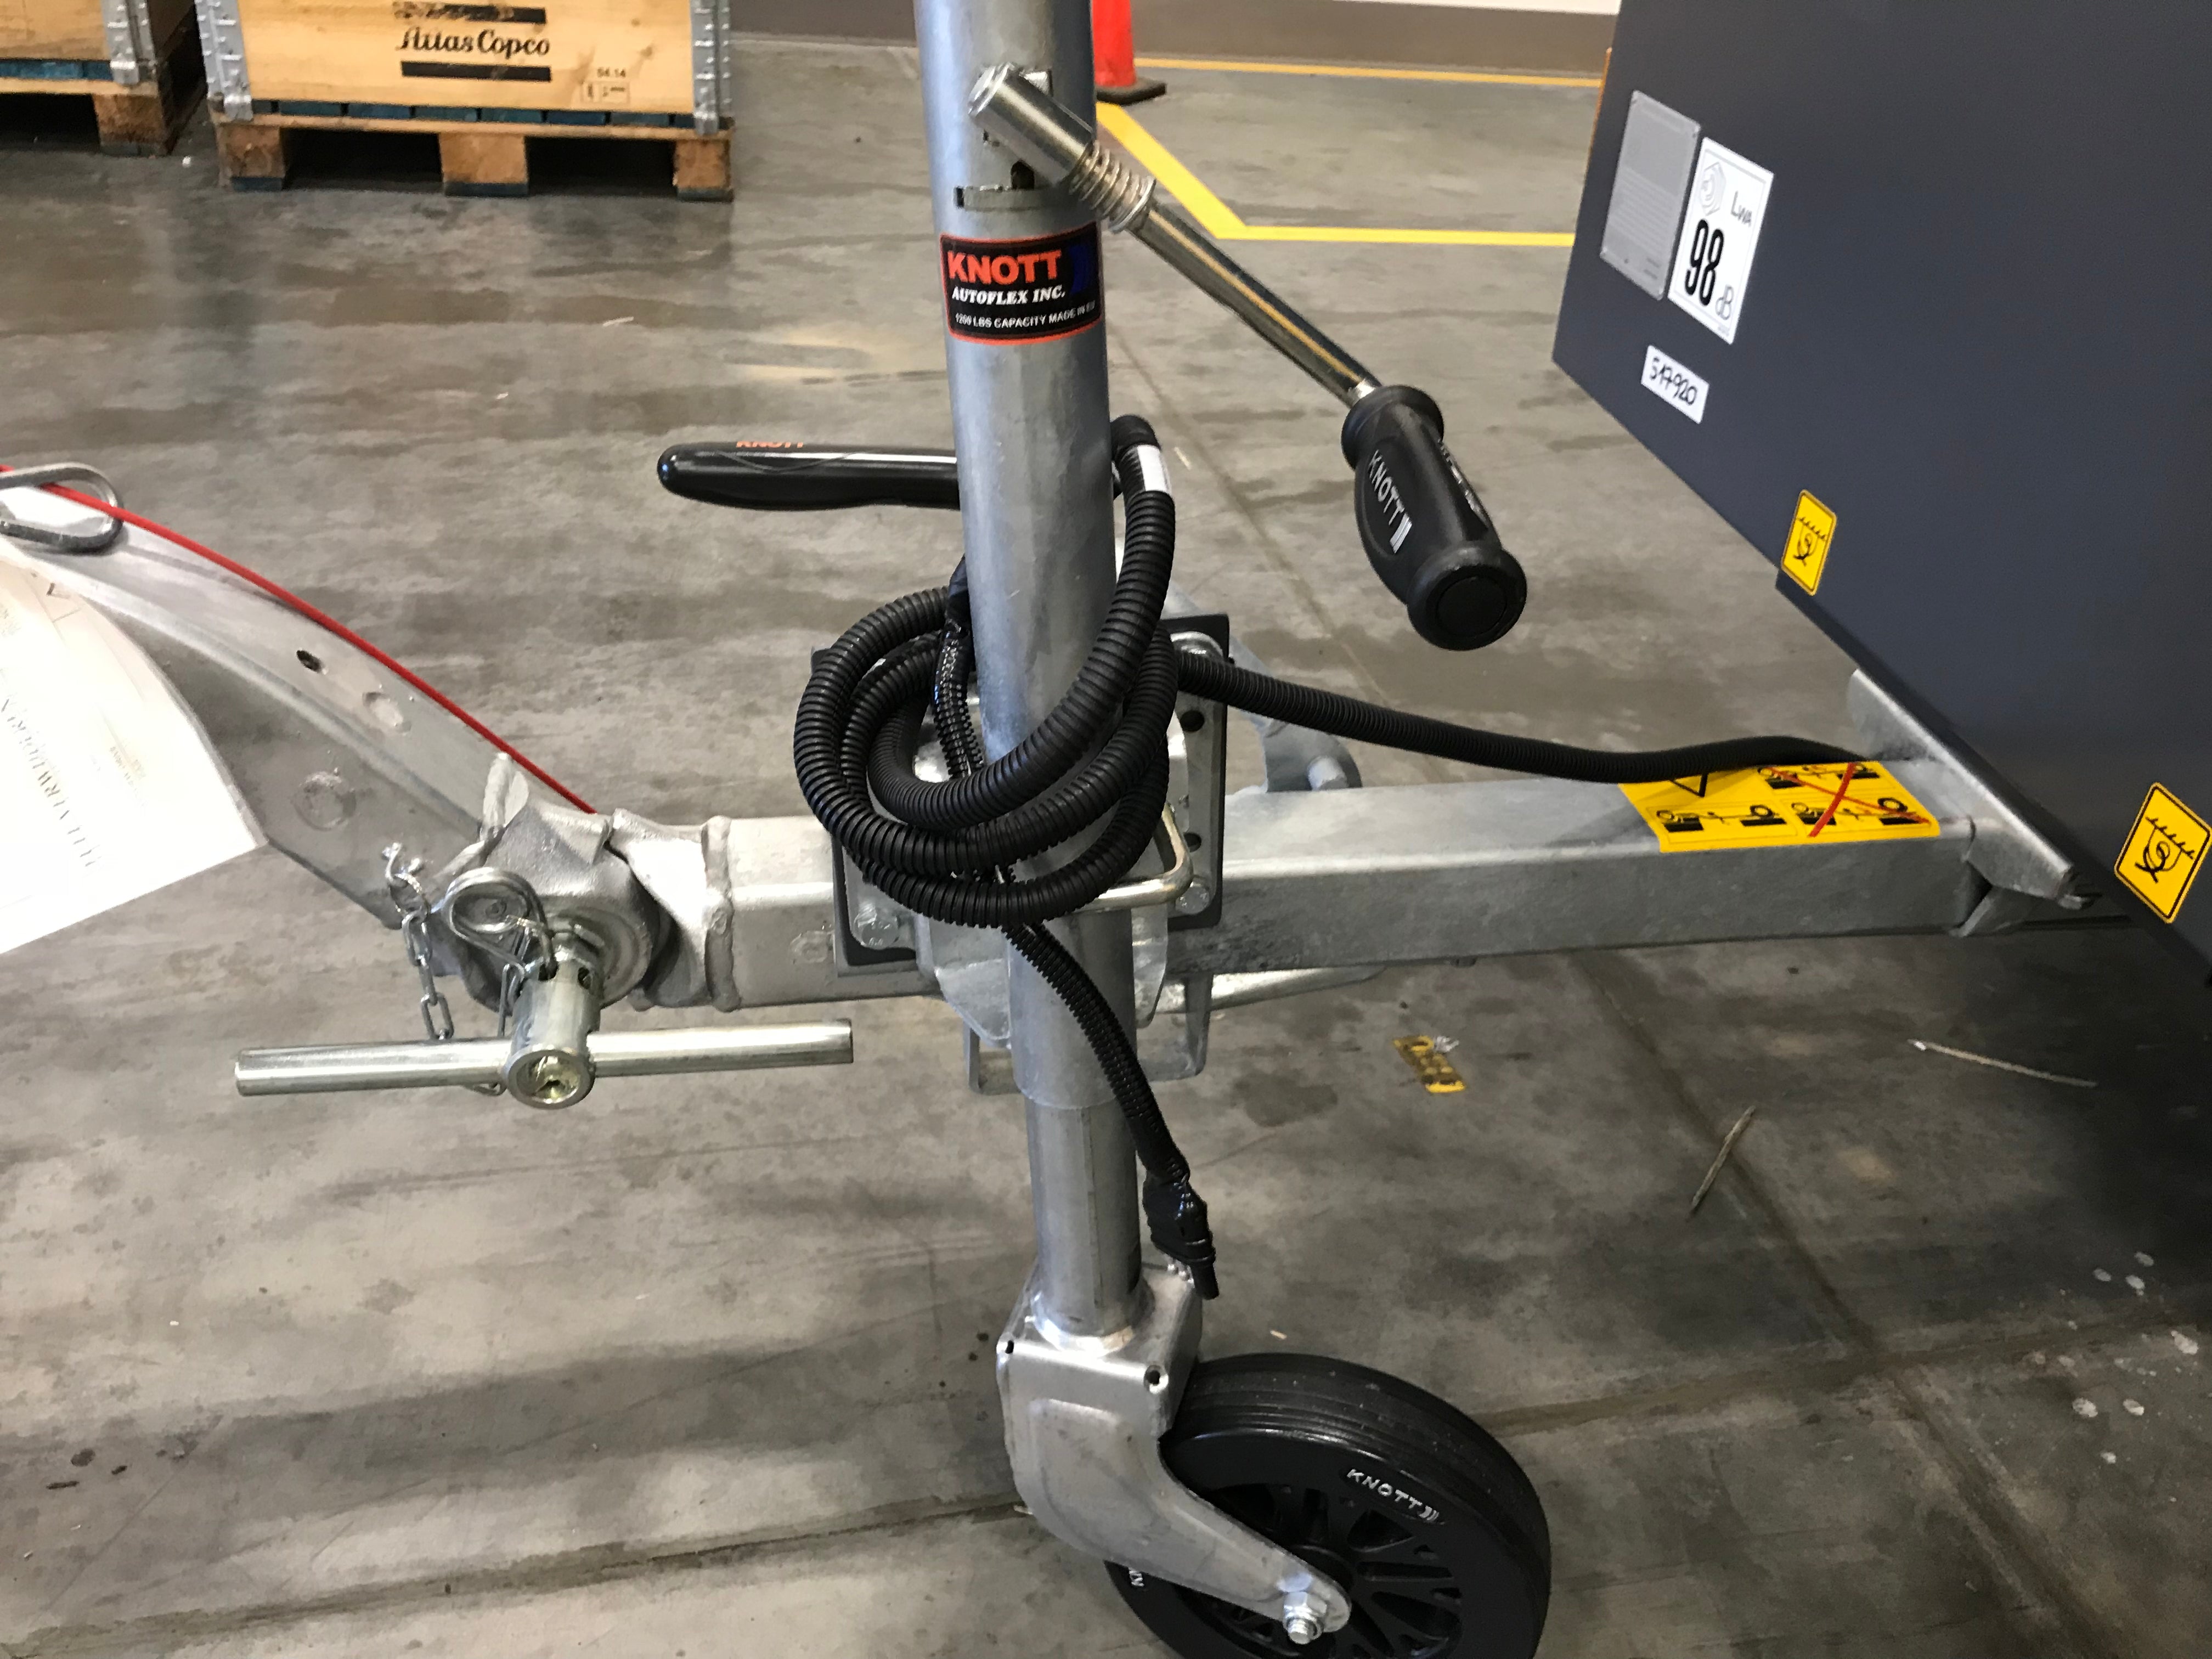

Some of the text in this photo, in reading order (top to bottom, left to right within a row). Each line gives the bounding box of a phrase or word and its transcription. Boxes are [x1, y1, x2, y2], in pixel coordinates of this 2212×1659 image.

[396, 26, 550, 59] Atlas Copco
[947, 250, 1062, 284] KNOTT
[1685, 218, 1724, 306] 98
[952, 285, 1066, 304] AUTOFLEX INC.
[1715, 285, 1735, 321] dB
[973, 315, 992, 328] LBS
[994, 314, 1046, 328] CAPACITY
[1049, 308, 1076, 324] MADE
[1368, 449, 1406, 526] KNOTT
[1346, 1469, 1423, 1509] KNOTT
